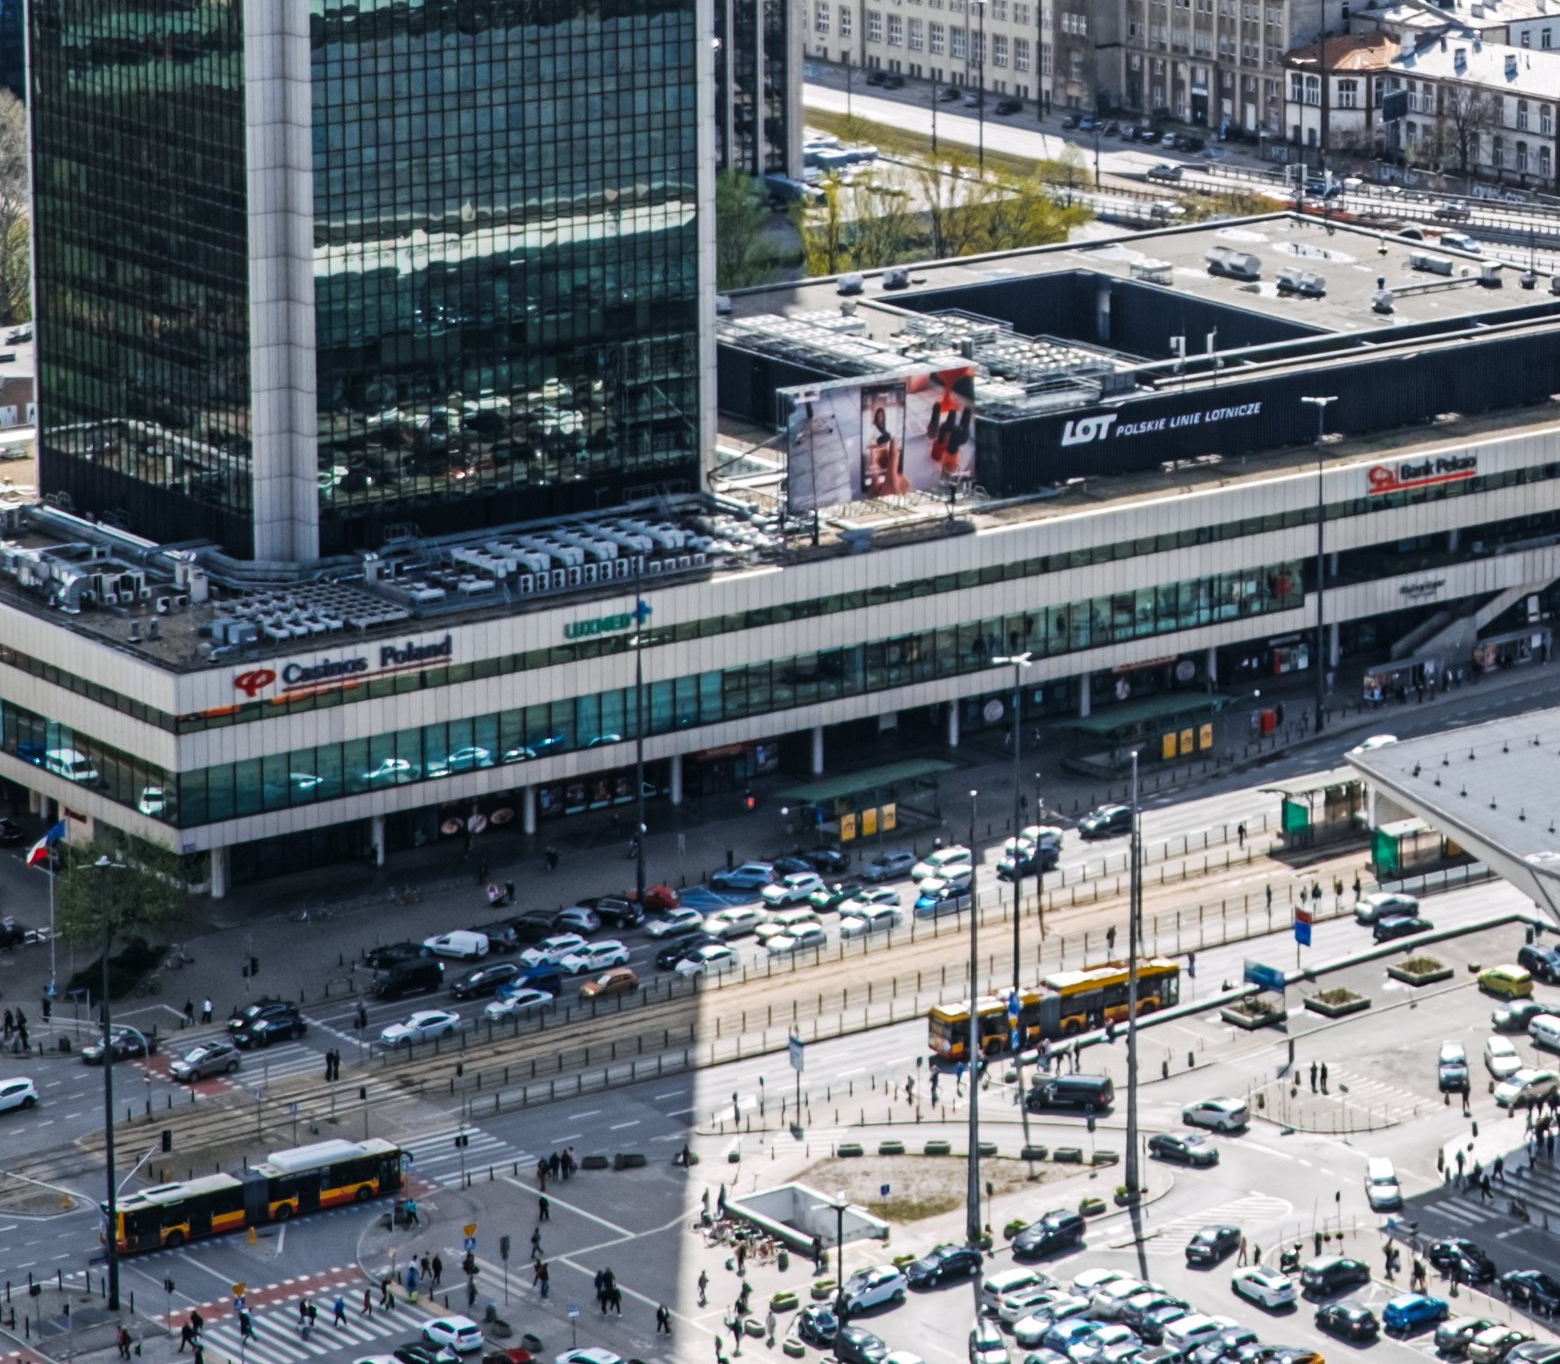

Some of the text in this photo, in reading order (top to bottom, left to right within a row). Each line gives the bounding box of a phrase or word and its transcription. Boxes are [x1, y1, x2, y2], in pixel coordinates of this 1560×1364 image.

[1060, 401, 1262, 447] LOT POLSKIE LINIE LOTNICZE
[1401, 455, 1477, 480] Bank Pekao
[282, 634, 453, 684] Casinos Poland
